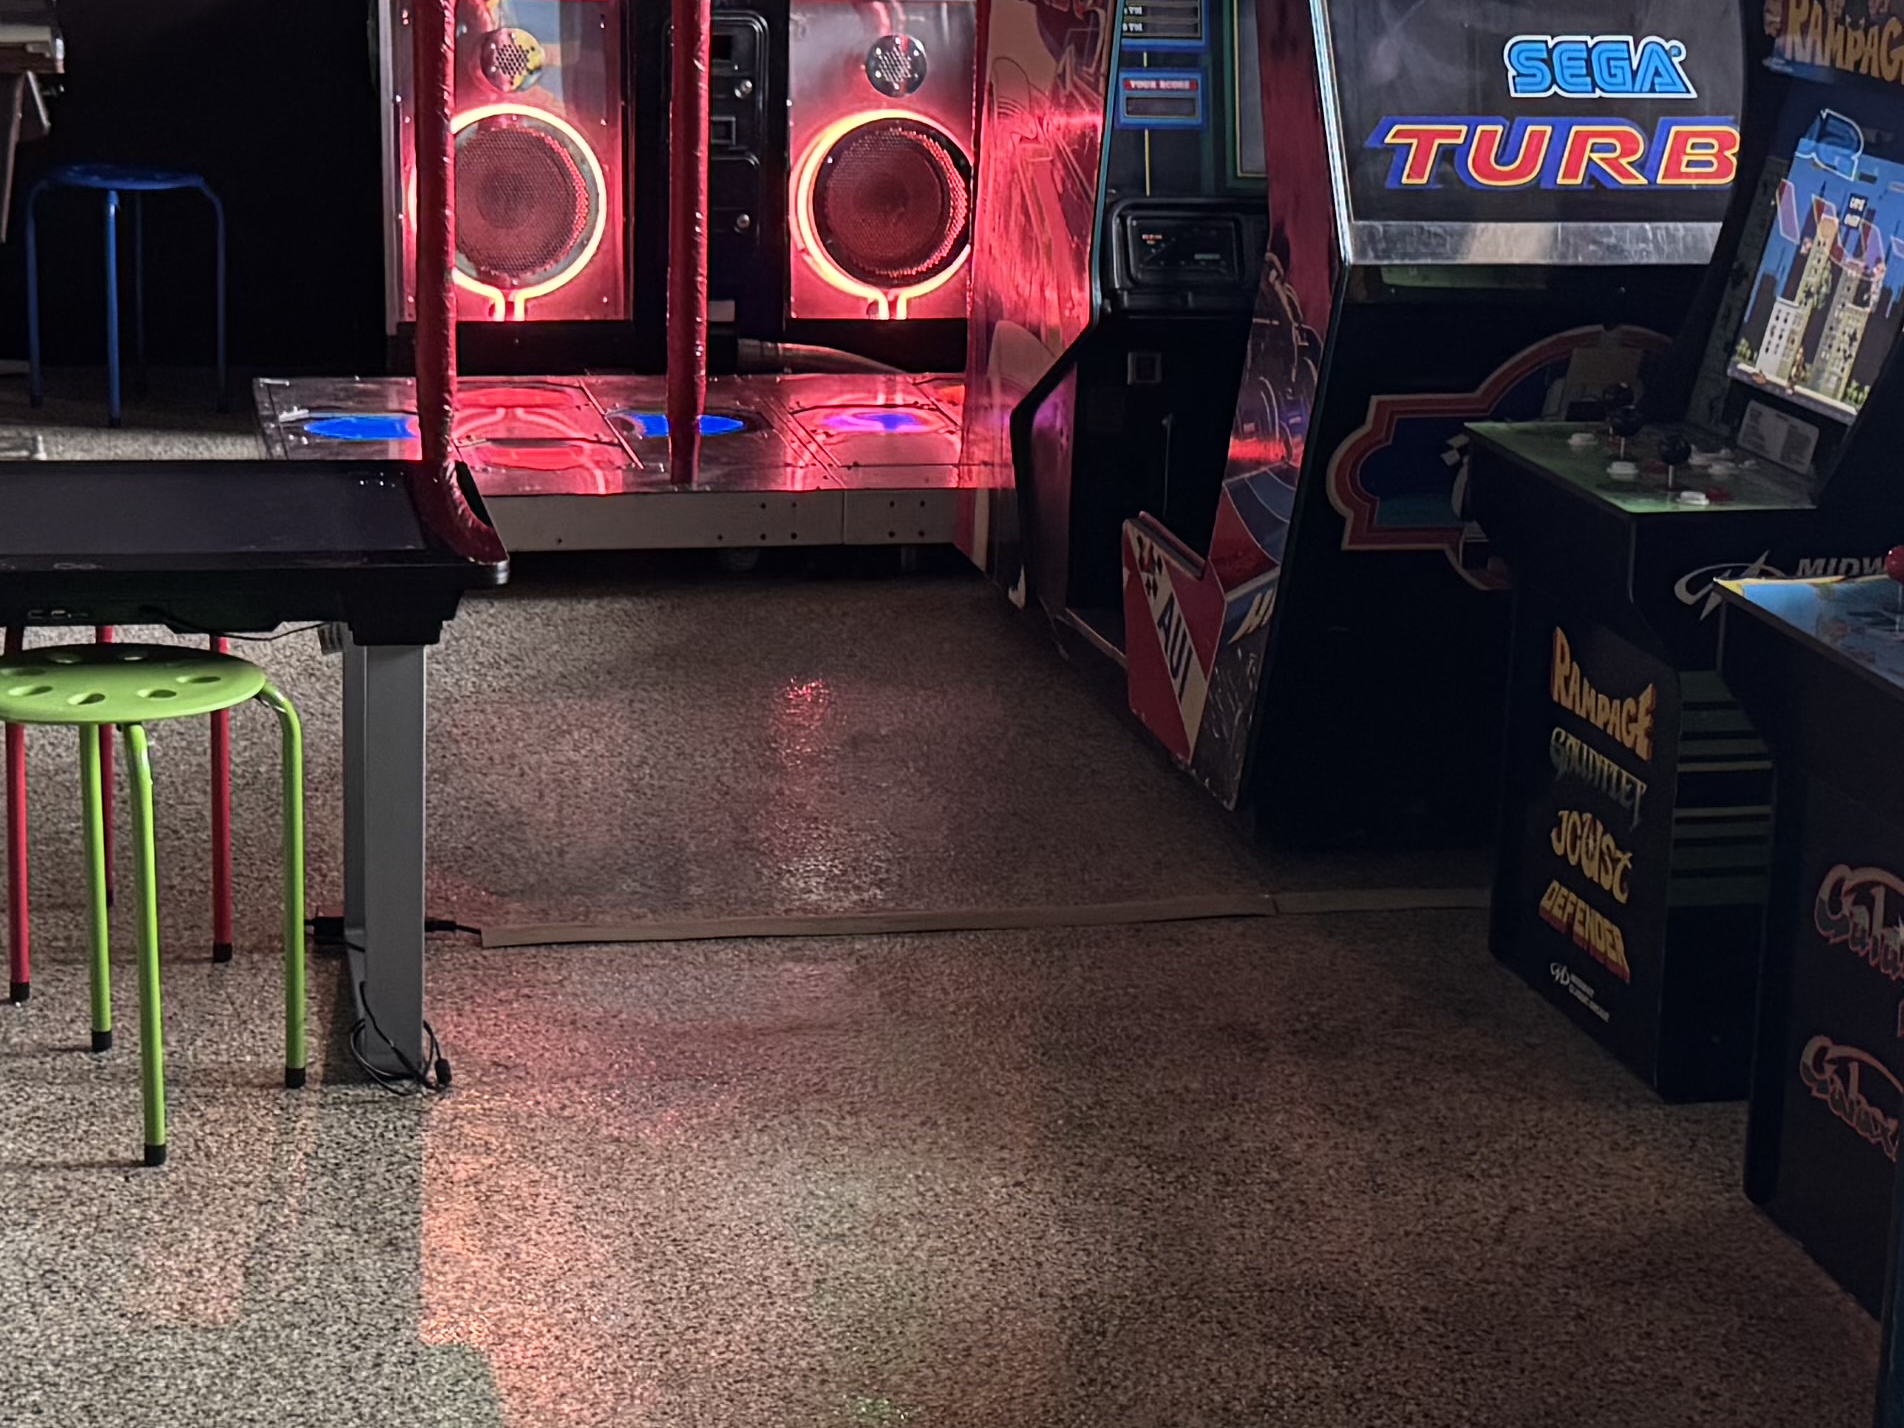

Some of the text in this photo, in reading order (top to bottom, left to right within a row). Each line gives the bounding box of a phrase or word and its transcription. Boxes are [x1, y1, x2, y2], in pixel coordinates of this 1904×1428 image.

[1504, 35, 1698, 98] SEGA
[1376, 119, 1742, 190] TURB
[1551, 626, 1656, 764] RAMPAGE
[1550, 726, 1648, 832] GAUNTLET
[1550, 810, 1634, 904] JOUST
[1539, 879, 1631, 984] DEFENDER
